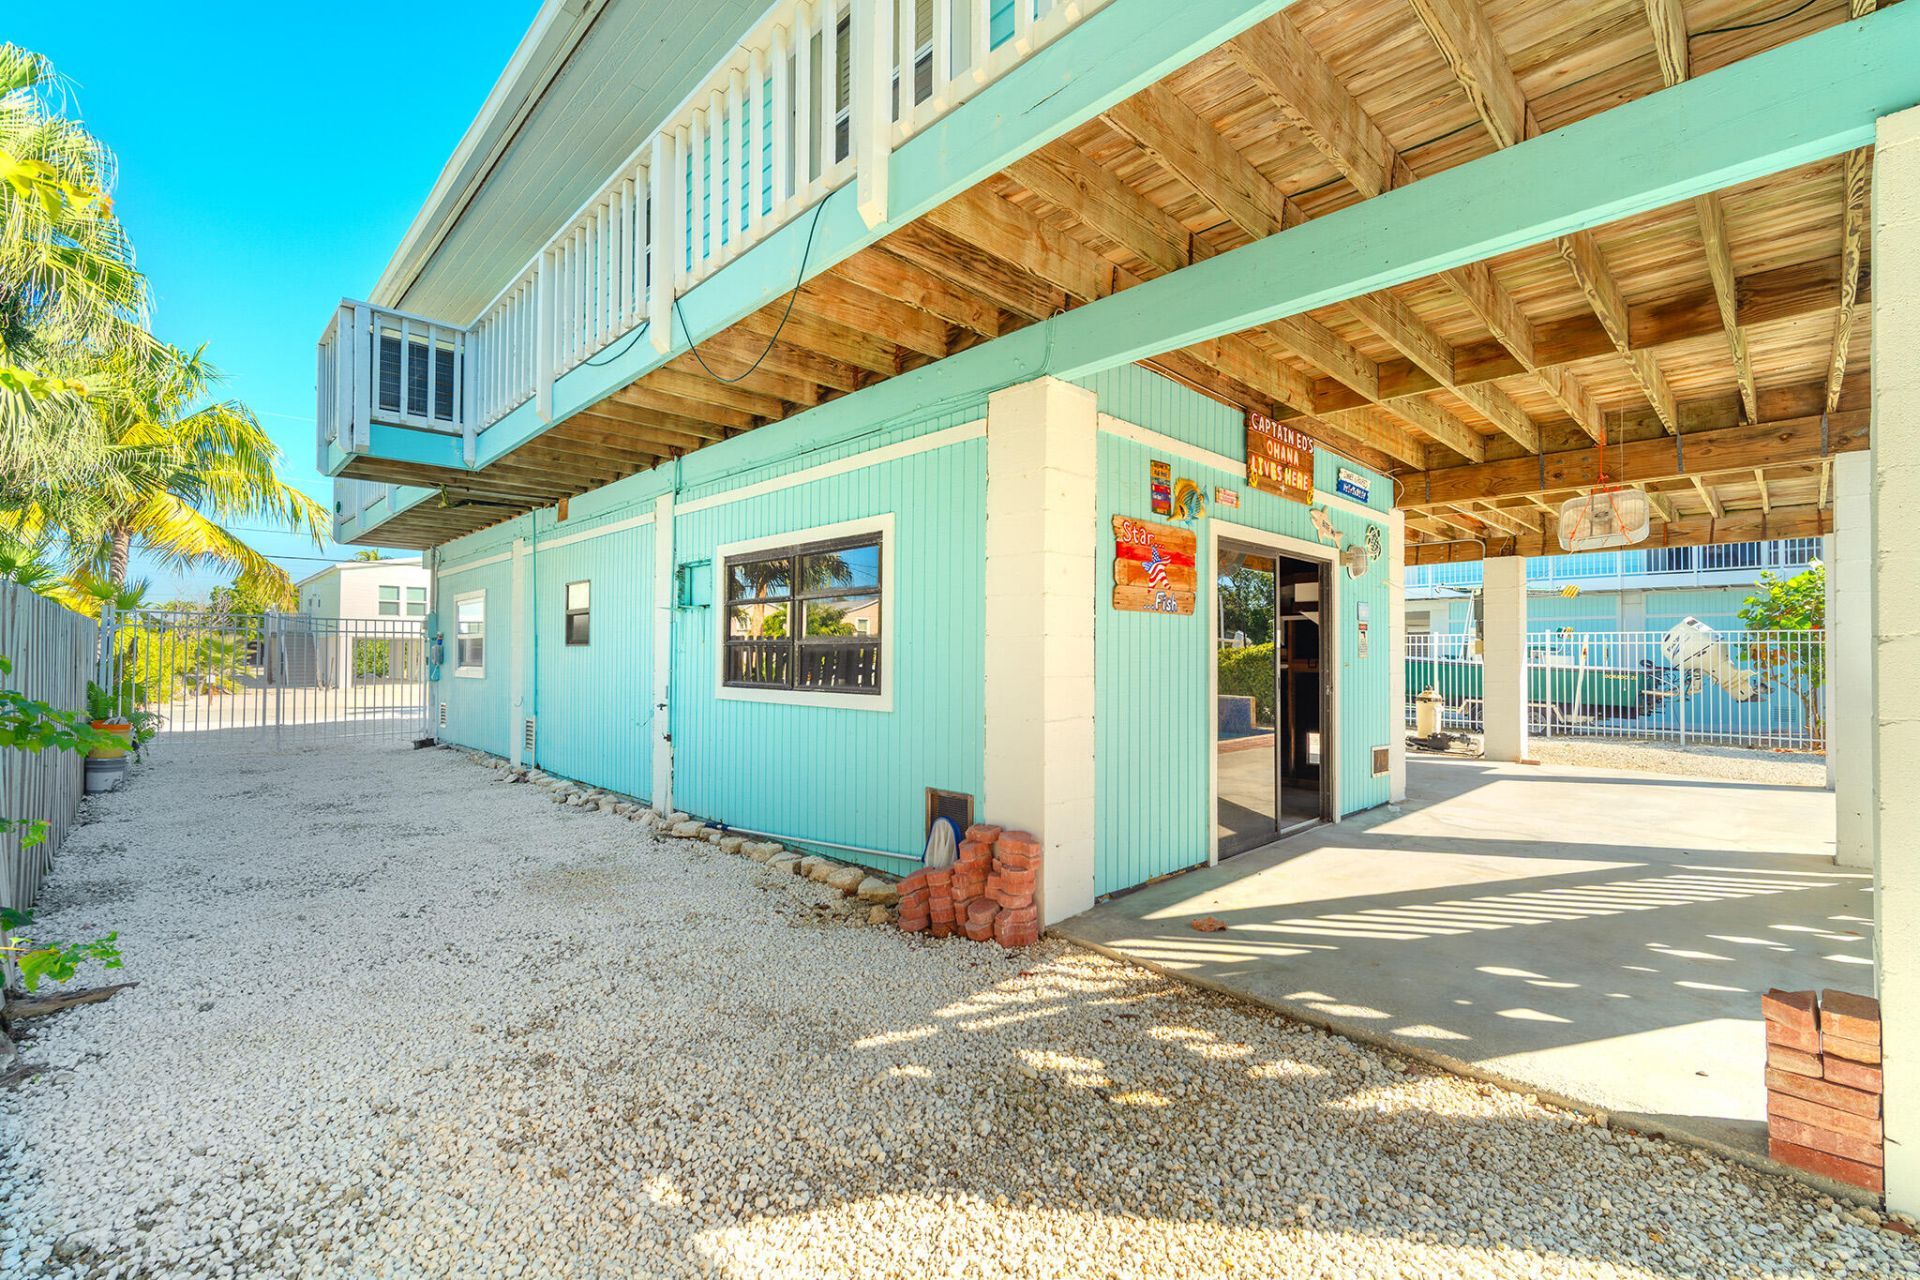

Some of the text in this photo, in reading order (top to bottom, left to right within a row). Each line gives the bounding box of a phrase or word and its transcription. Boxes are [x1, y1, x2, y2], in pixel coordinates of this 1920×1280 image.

[1251, 412, 1314, 454] CAPTAIN ED'S
[1266, 440, 1300, 467] OHANA
[1250, 455, 1309, 491] LIVES HERE
